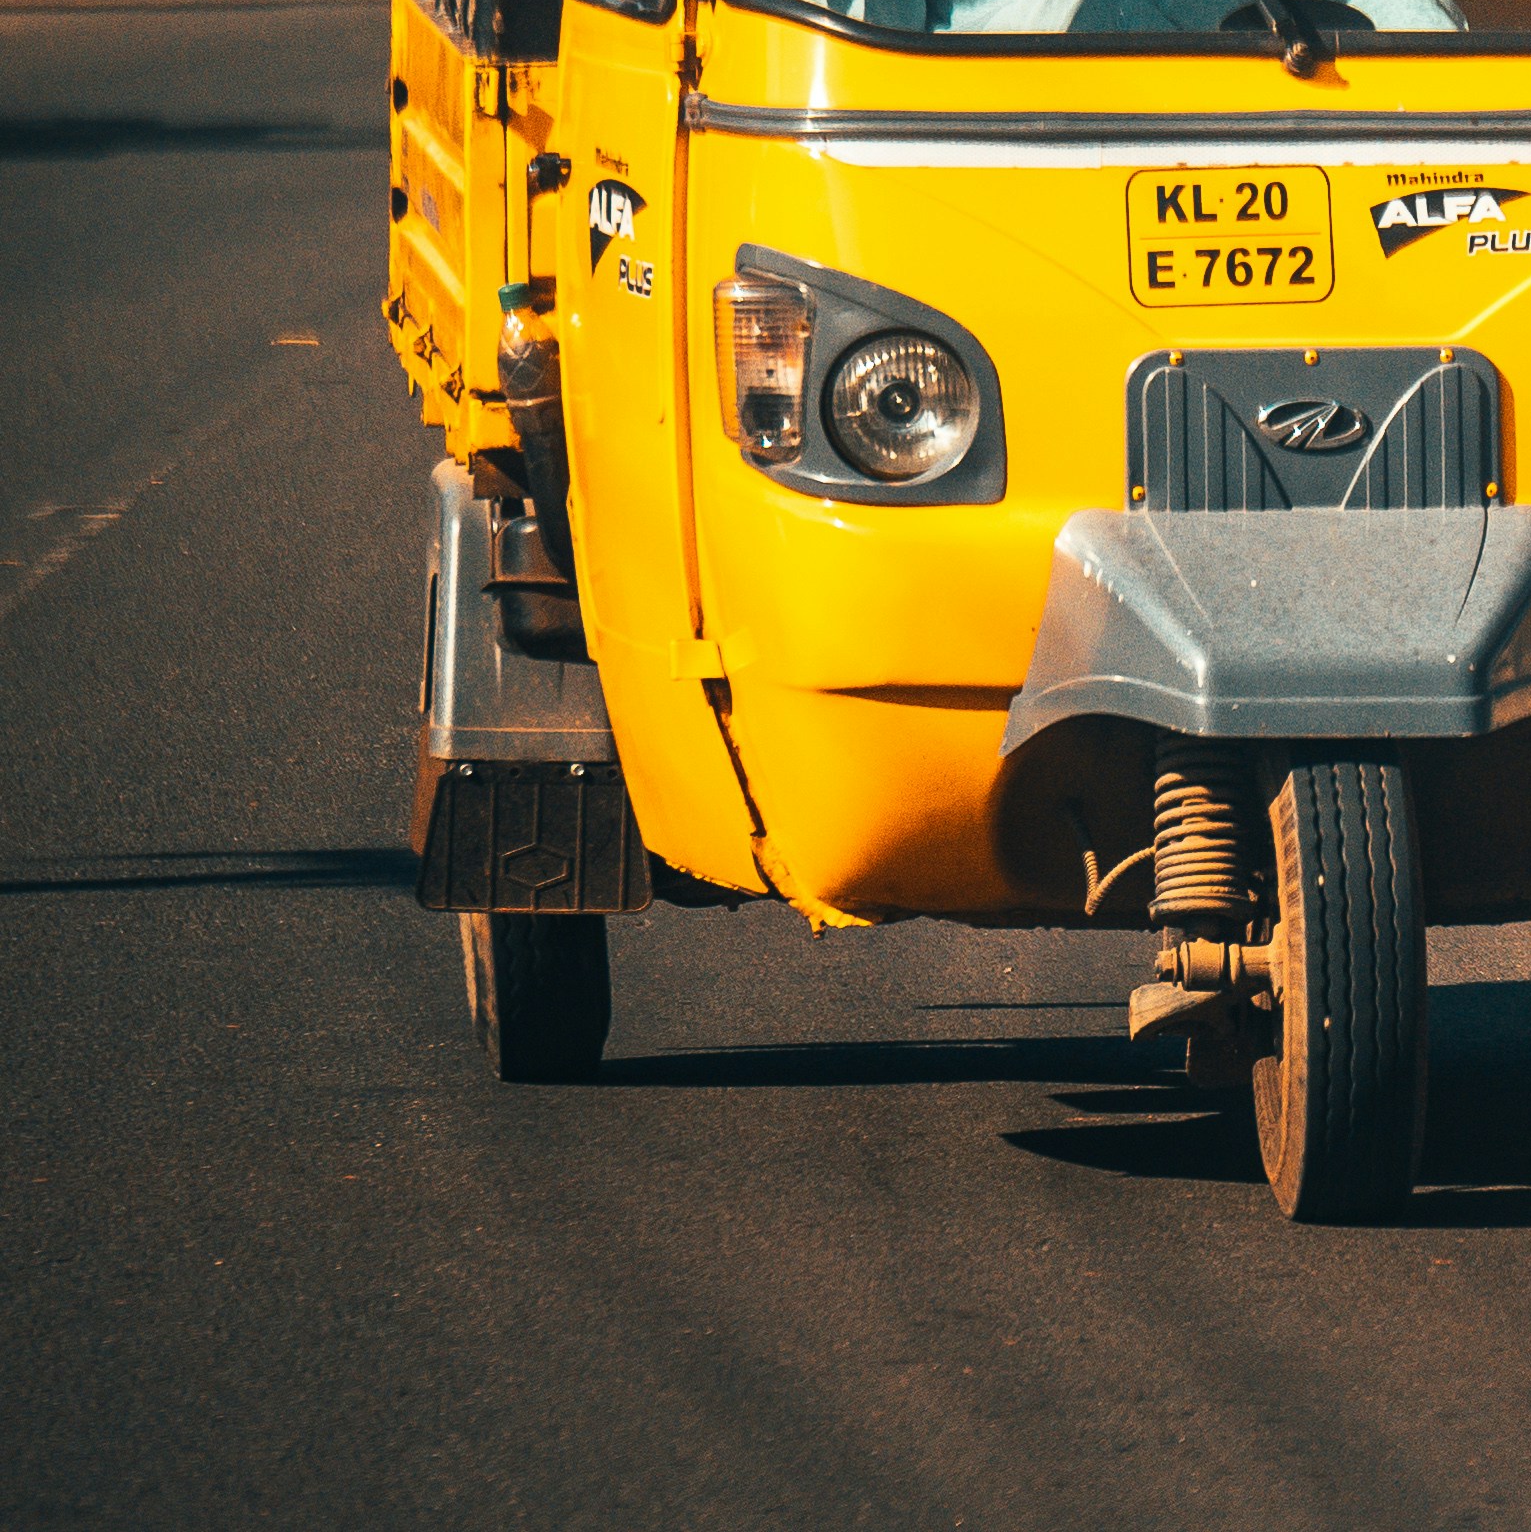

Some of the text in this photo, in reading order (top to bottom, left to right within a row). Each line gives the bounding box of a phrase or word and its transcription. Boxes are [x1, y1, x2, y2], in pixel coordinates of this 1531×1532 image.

[1386, 171, 1486, 186] Mahindra
[589, 185, 636, 242] ALFA
[1156, 181, 1290, 224] KL 20
[1377, 194, 1507, 229] ALFA
[618, 255, 654, 298] PLUS
[1147, 246, 1316, 289] E 7672
